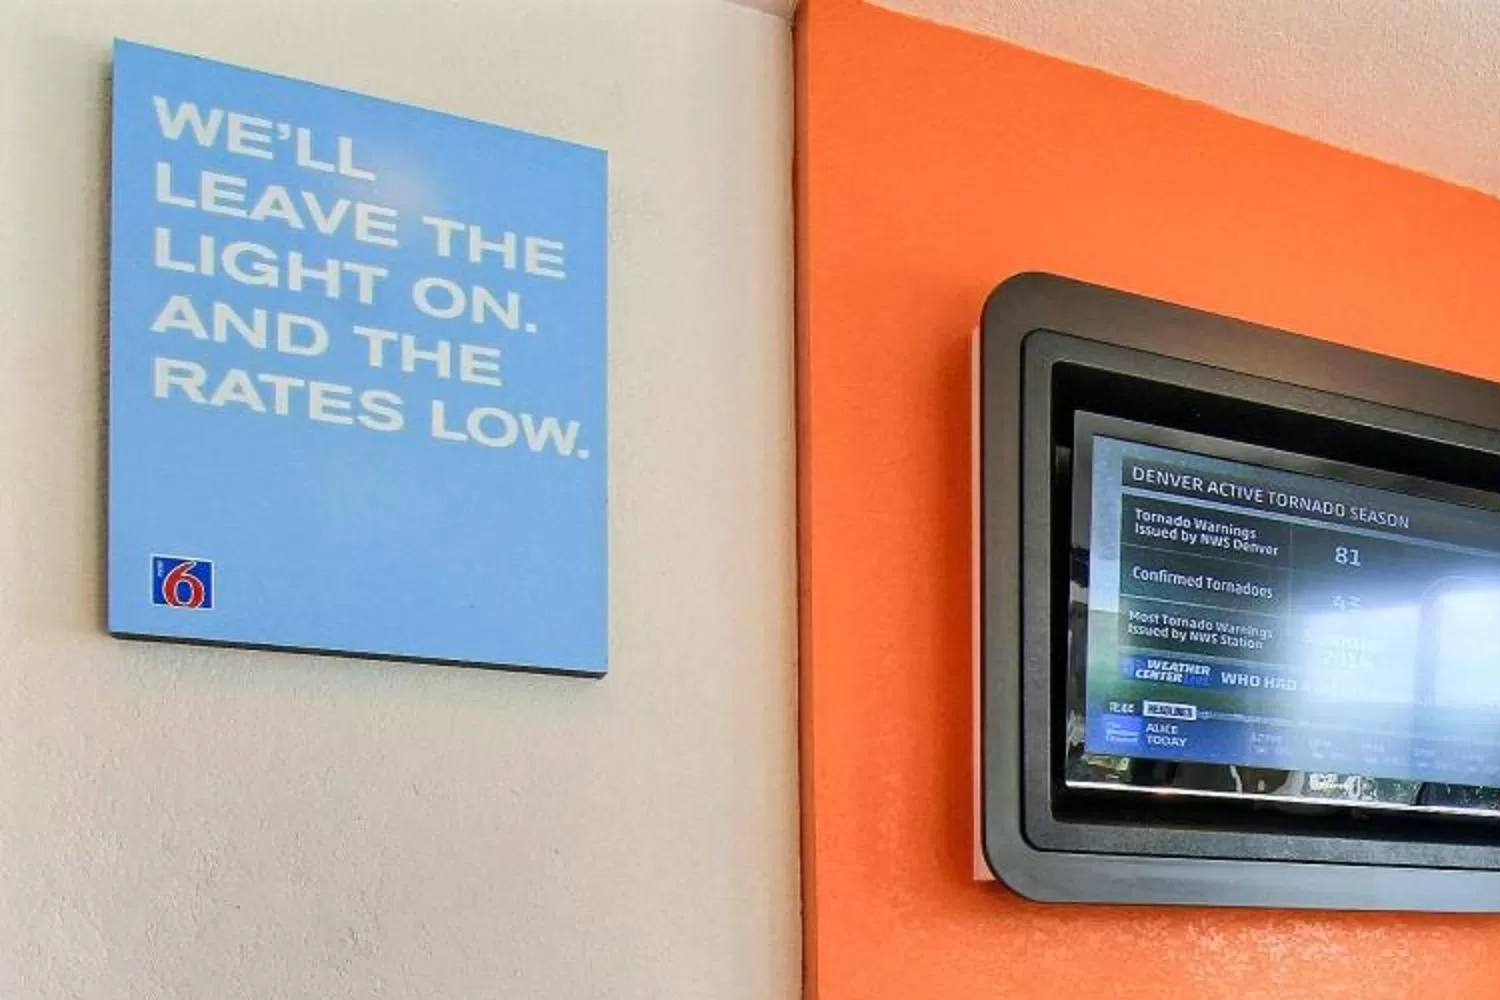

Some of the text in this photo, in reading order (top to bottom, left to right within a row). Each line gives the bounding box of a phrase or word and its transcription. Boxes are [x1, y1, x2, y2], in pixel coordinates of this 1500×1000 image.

[153, 96, 376, 181] WE'LL
[156, 162, 567, 279] LEAVE THE
[156, 227, 537, 333] LIGHT ON.
[150, 295, 503, 387] AND THE
[153, 358, 590, 459] RATES LOW.
[1132, 466, 1409, 529] DENVER ACTIVE TORNADO SEASON
[1135, 508, 1257, 541] Tornado Warnings
[1135, 522, 1279, 556] Issued by NWS Denver
[1335, 545, 1361, 567] 81
[1132, 565, 1273, 599] Confirmed Tornadoes
[1127, 623, 1264, 649] Issued by NWS Station
[1129, 610, 1273, 640] Most Tornado Warnings
[1135, 669, 1183, 683] CENTER
[1147, 659, 1211, 676] WEATHER
[1221, 672, 1260, 687] WHO
[1263, 676, 1297, 691] HAD
[1146, 735, 1188, 748] TODAY
